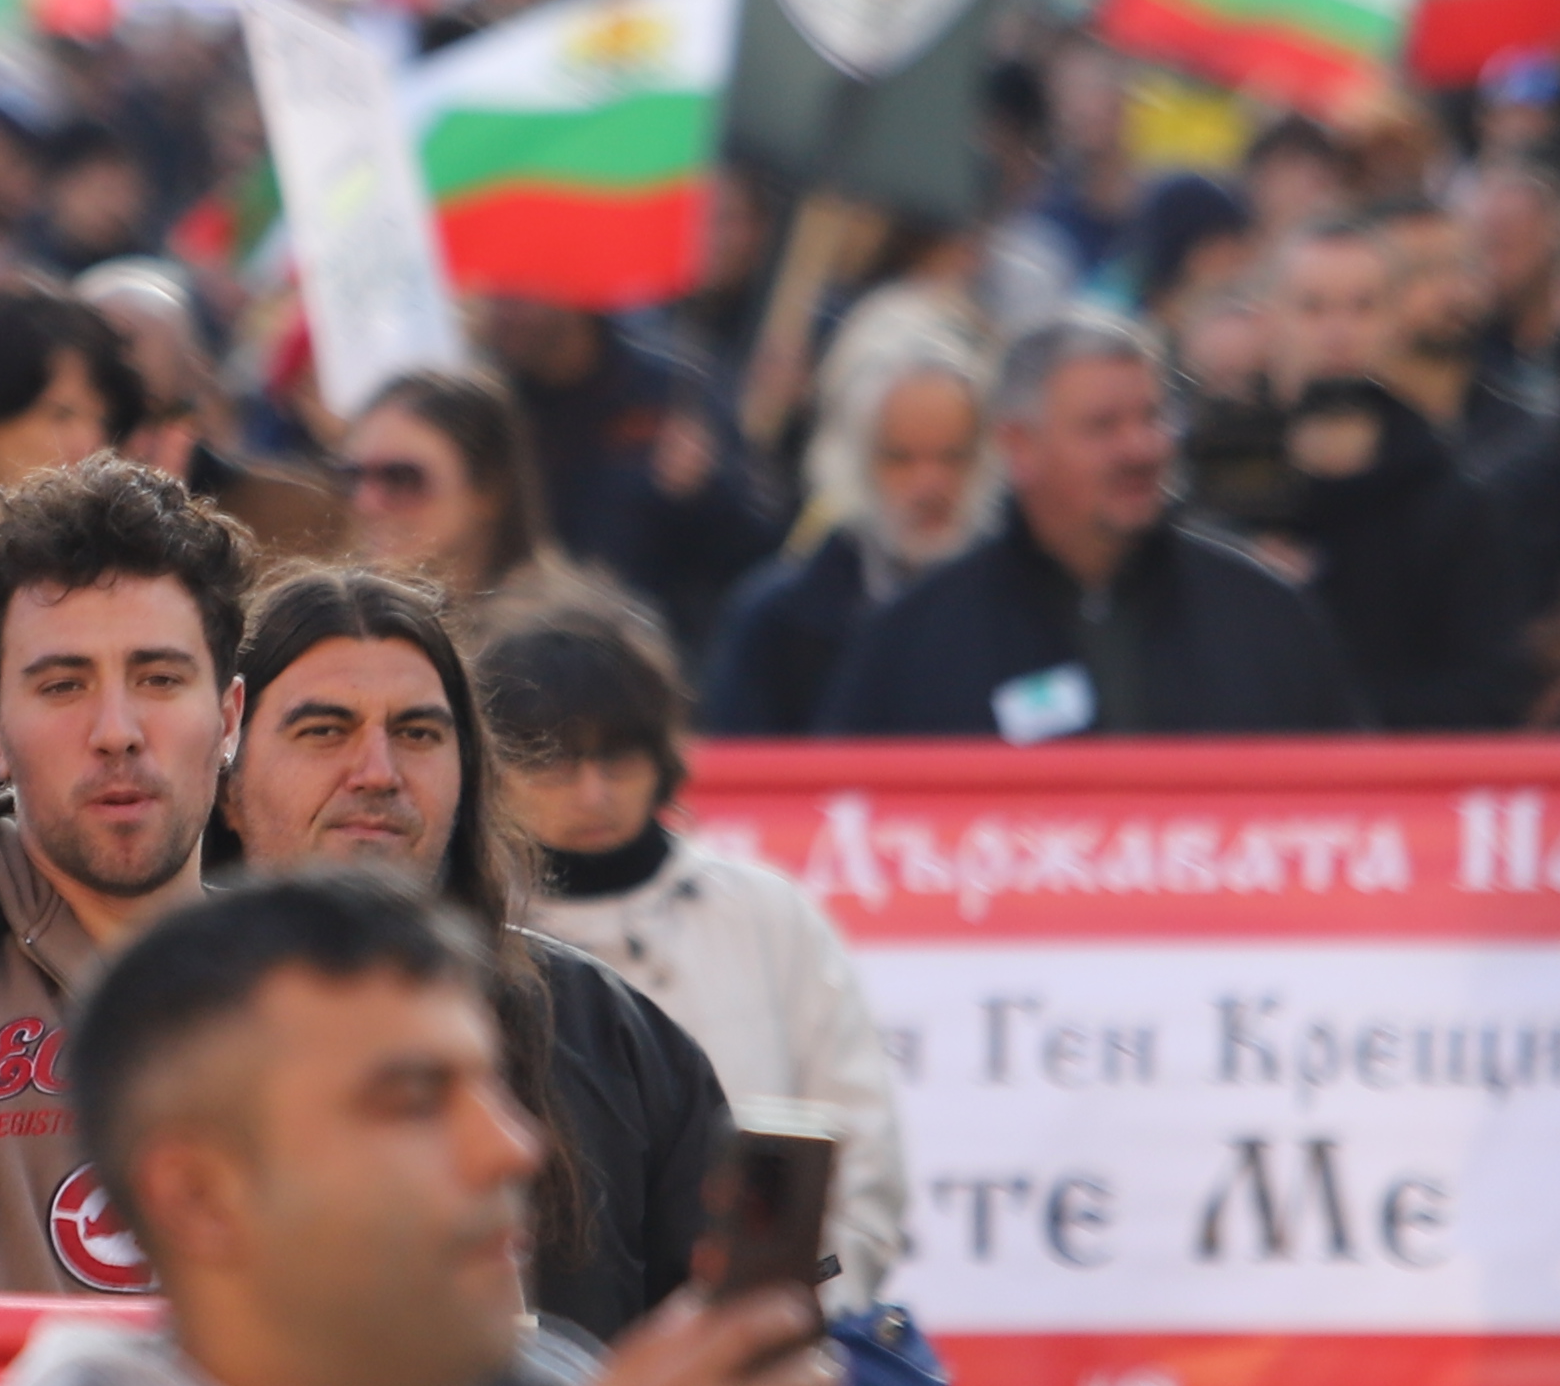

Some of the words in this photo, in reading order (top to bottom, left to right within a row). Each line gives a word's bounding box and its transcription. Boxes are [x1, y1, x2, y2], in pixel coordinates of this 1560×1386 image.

[804, 791, 1412, 921] Държавата
[980, 993, 1156, 1090] Ген
[906, 1169, 1116, 1273] те
[1196, 1133, 1452, 1273] Ме
